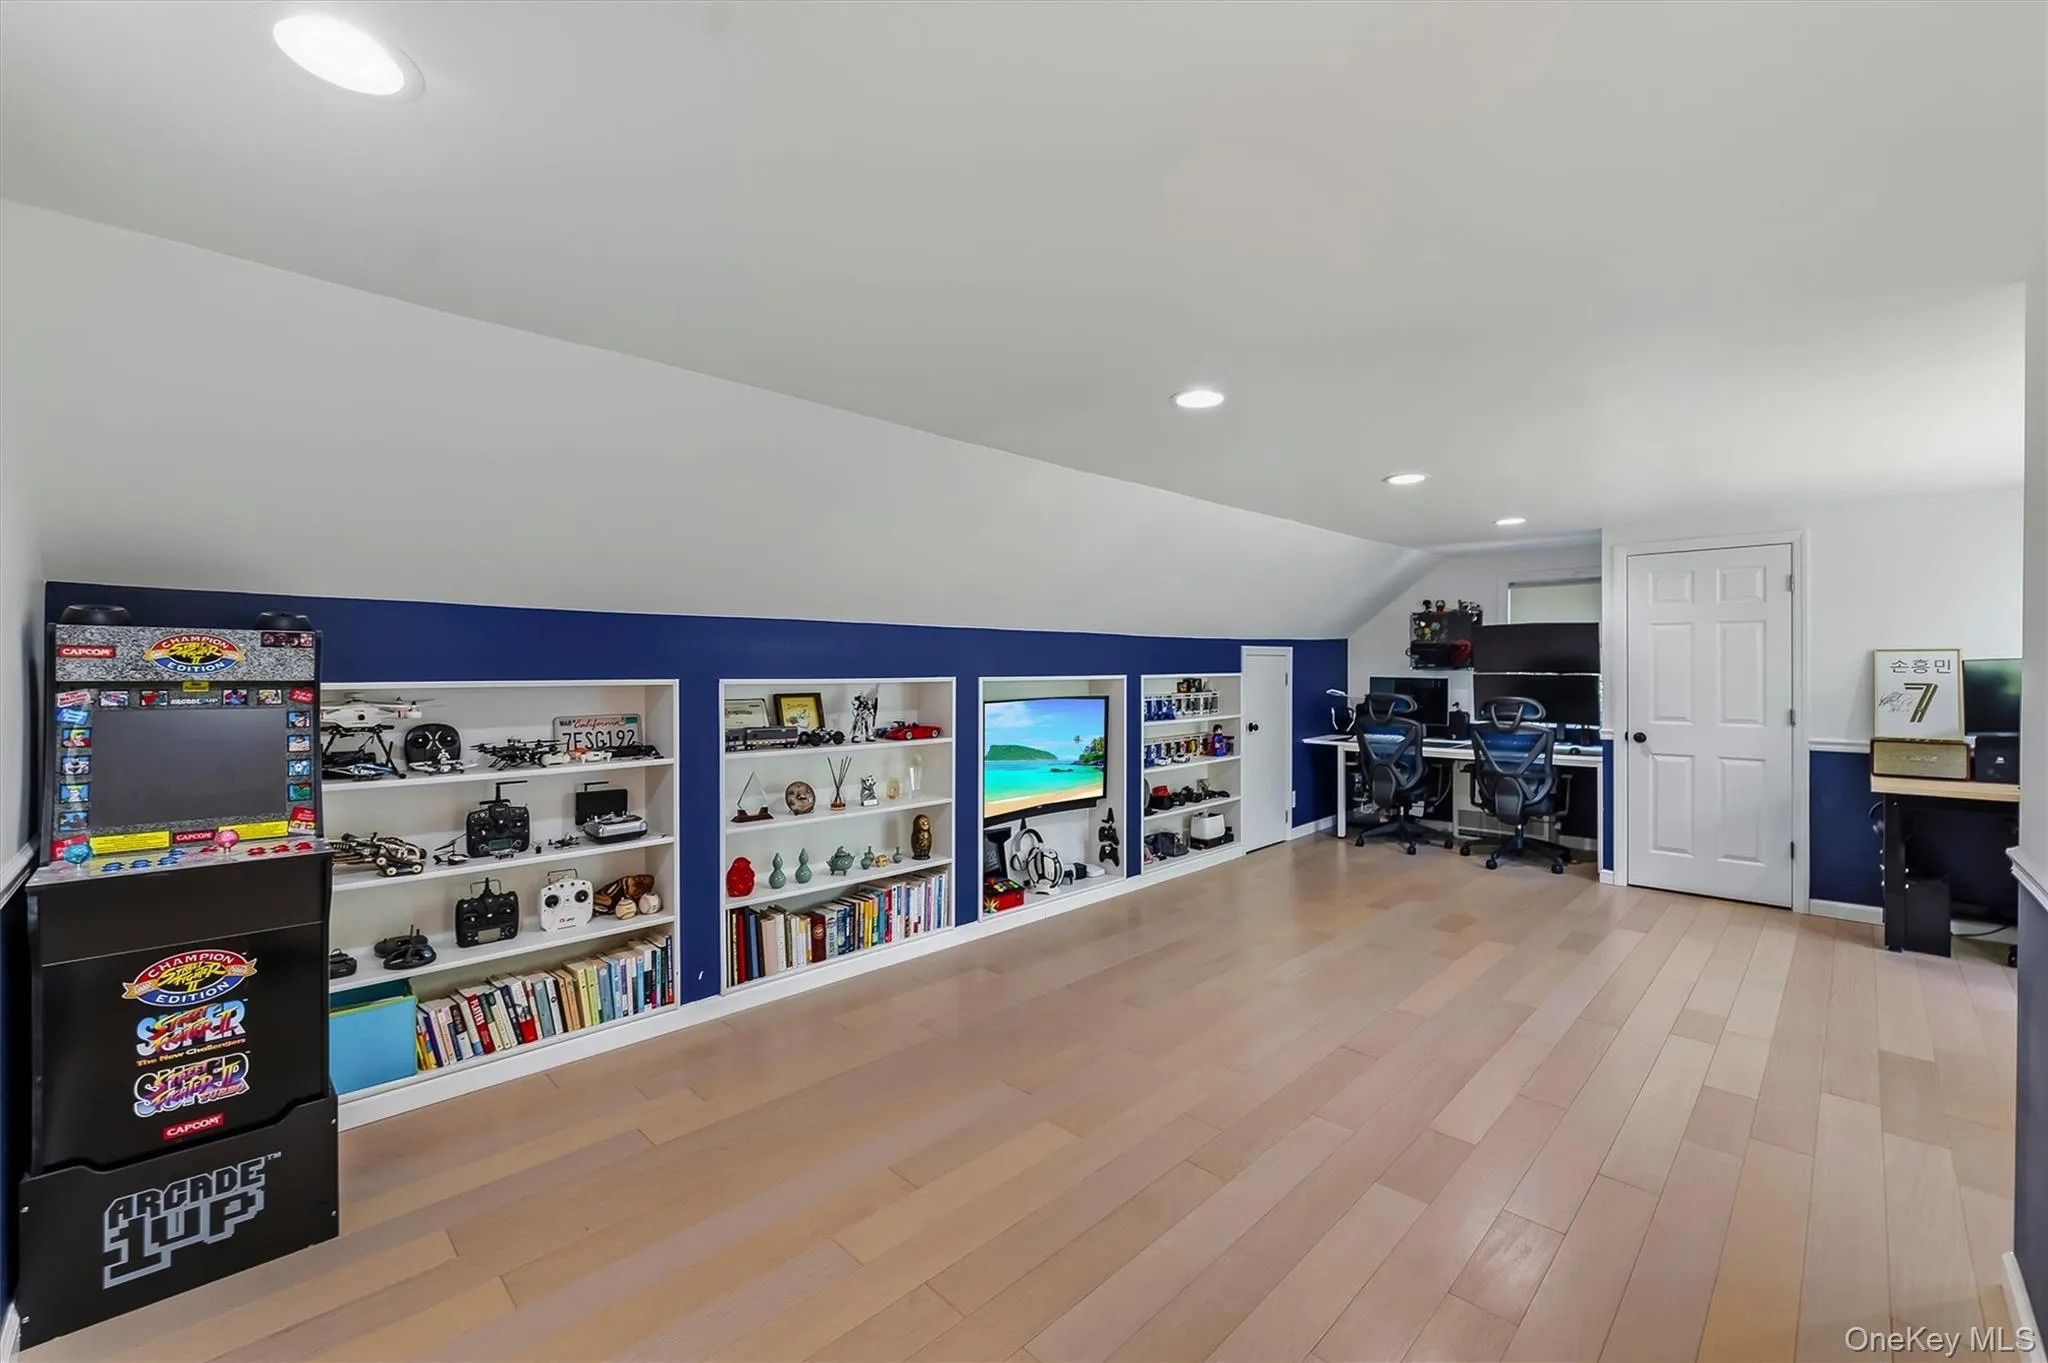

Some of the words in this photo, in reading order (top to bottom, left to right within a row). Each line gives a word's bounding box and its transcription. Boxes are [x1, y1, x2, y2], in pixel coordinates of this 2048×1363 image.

[62, 648, 110, 656] CAPCOM
[161, 635, 231, 649] CHAMPION
[167, 661, 225, 673] EDITION
[1890, 659, 1951, 674] 손흥민
[1903, 682, 1939, 723] 7
[573, 718, 622, 730] California
[176, 832, 213, 841] CAPCOM
[148, 953, 234, 978] CHAMPION
[155, 980, 229, 1004] EDITION
[135, 1059, 157, 1067] The
[160, 1052, 185, 1062] New
[186, 1038, 246, 1055] Challengers
[166, 1116, 220, 1136] CAPCOM
[103, 1156, 265, 1230] ARCADE
[103, 1187, 265, 1290] 1UP
